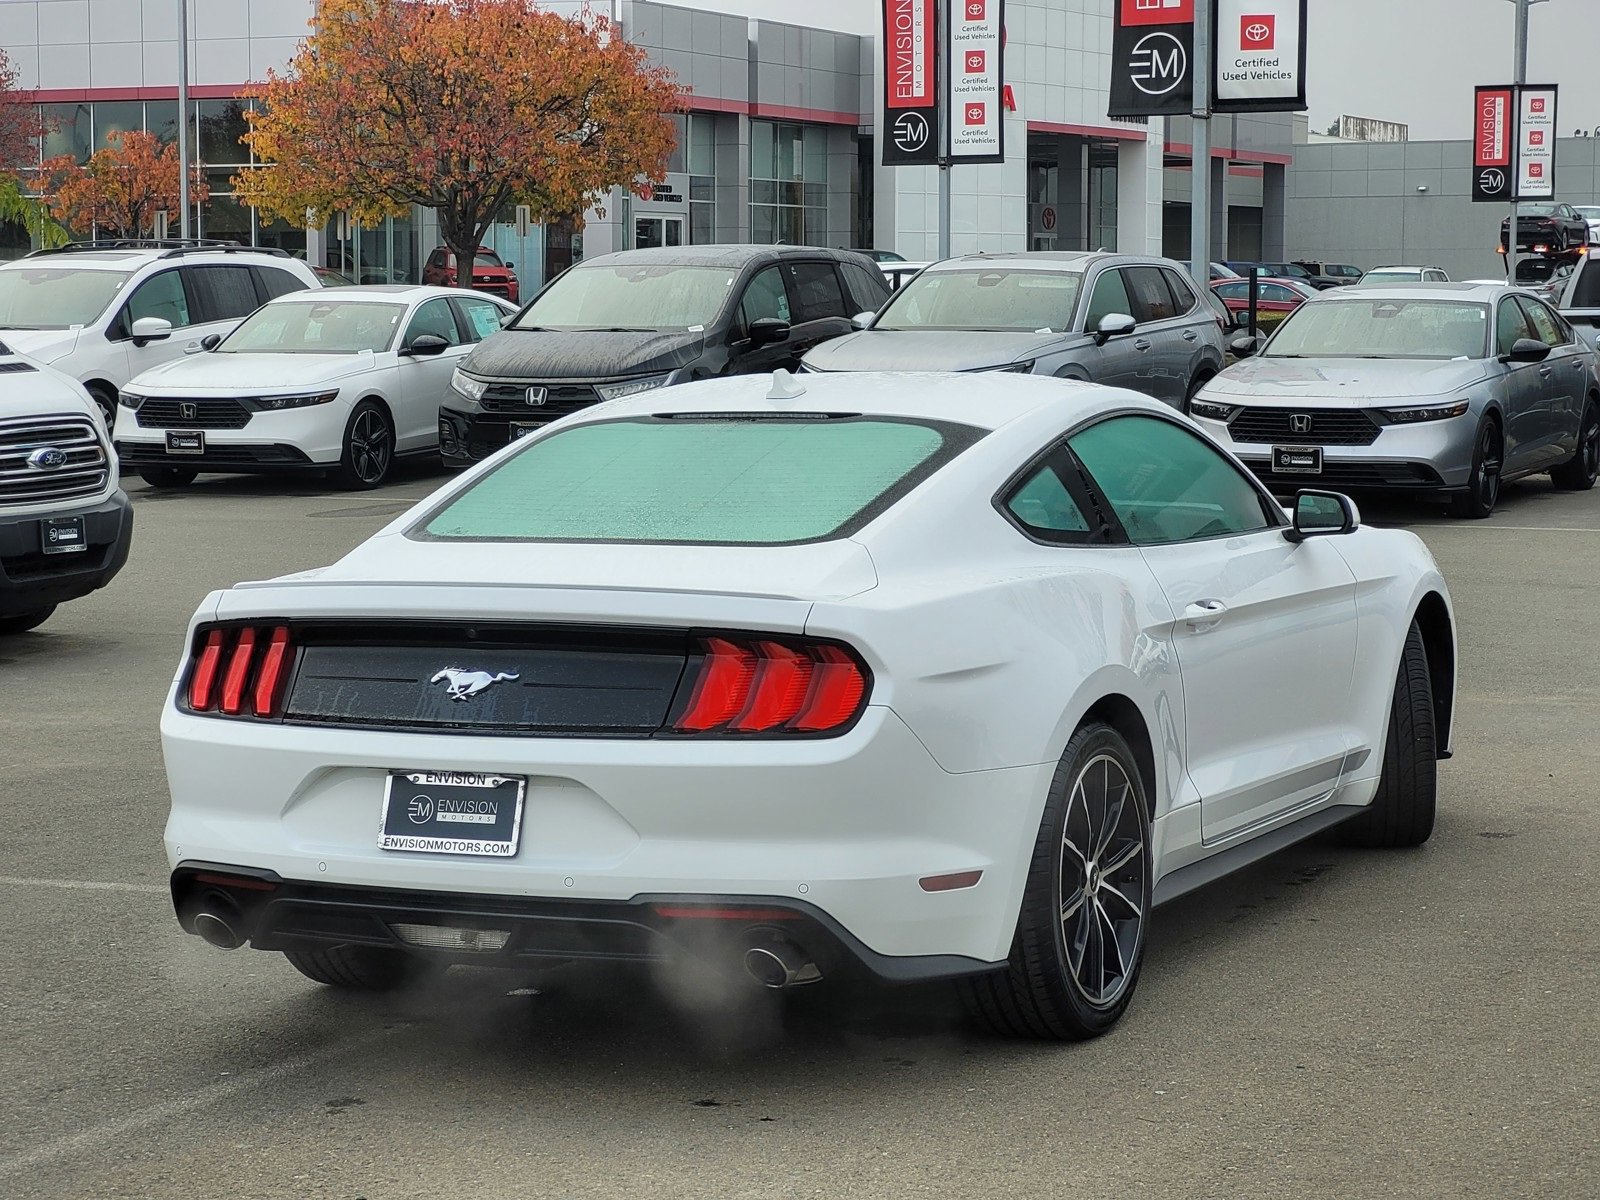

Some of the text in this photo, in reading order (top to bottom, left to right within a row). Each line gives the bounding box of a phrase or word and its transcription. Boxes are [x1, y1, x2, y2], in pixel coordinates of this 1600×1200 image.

[896, 0, 912, 98] ENVISION
[1234, 58, 1279, 68] Certified
[1222, 70, 1292, 81] Used Vehicles
[1482, 97, 1495, 160] ENVISION
[45, 453, 62, 464] Ford
[426, 772, 486, 785] ENVISION
[437, 800, 498, 814] ENVISION
[384, 837, 510, 854] ENVISIONMOTORS.COM
